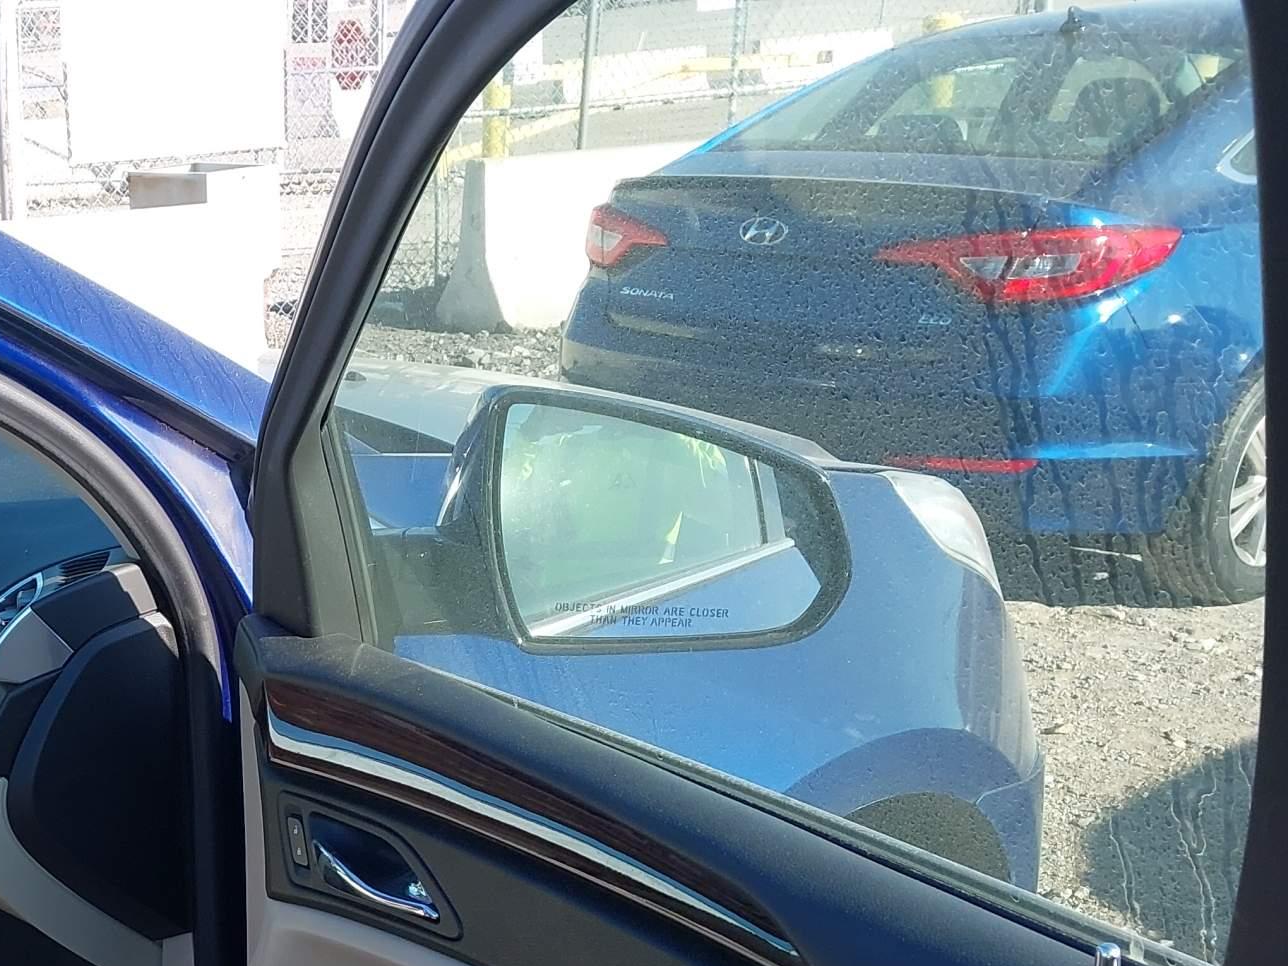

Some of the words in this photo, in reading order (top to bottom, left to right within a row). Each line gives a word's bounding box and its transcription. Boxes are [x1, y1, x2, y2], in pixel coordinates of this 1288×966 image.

[619, 286, 674, 300] SONATA
[554, 602, 602, 613] OBJECTS
[606, 603, 616, 614] IN
[620, 604, 659, 616] MIRROR
[663, 606, 685, 617] ARE
[689, 607, 729, 618] CLOSER
[590, 614, 617, 625] THAN
[622, 615, 647, 626] THEY
[650, 616, 692, 628] APPEAR
